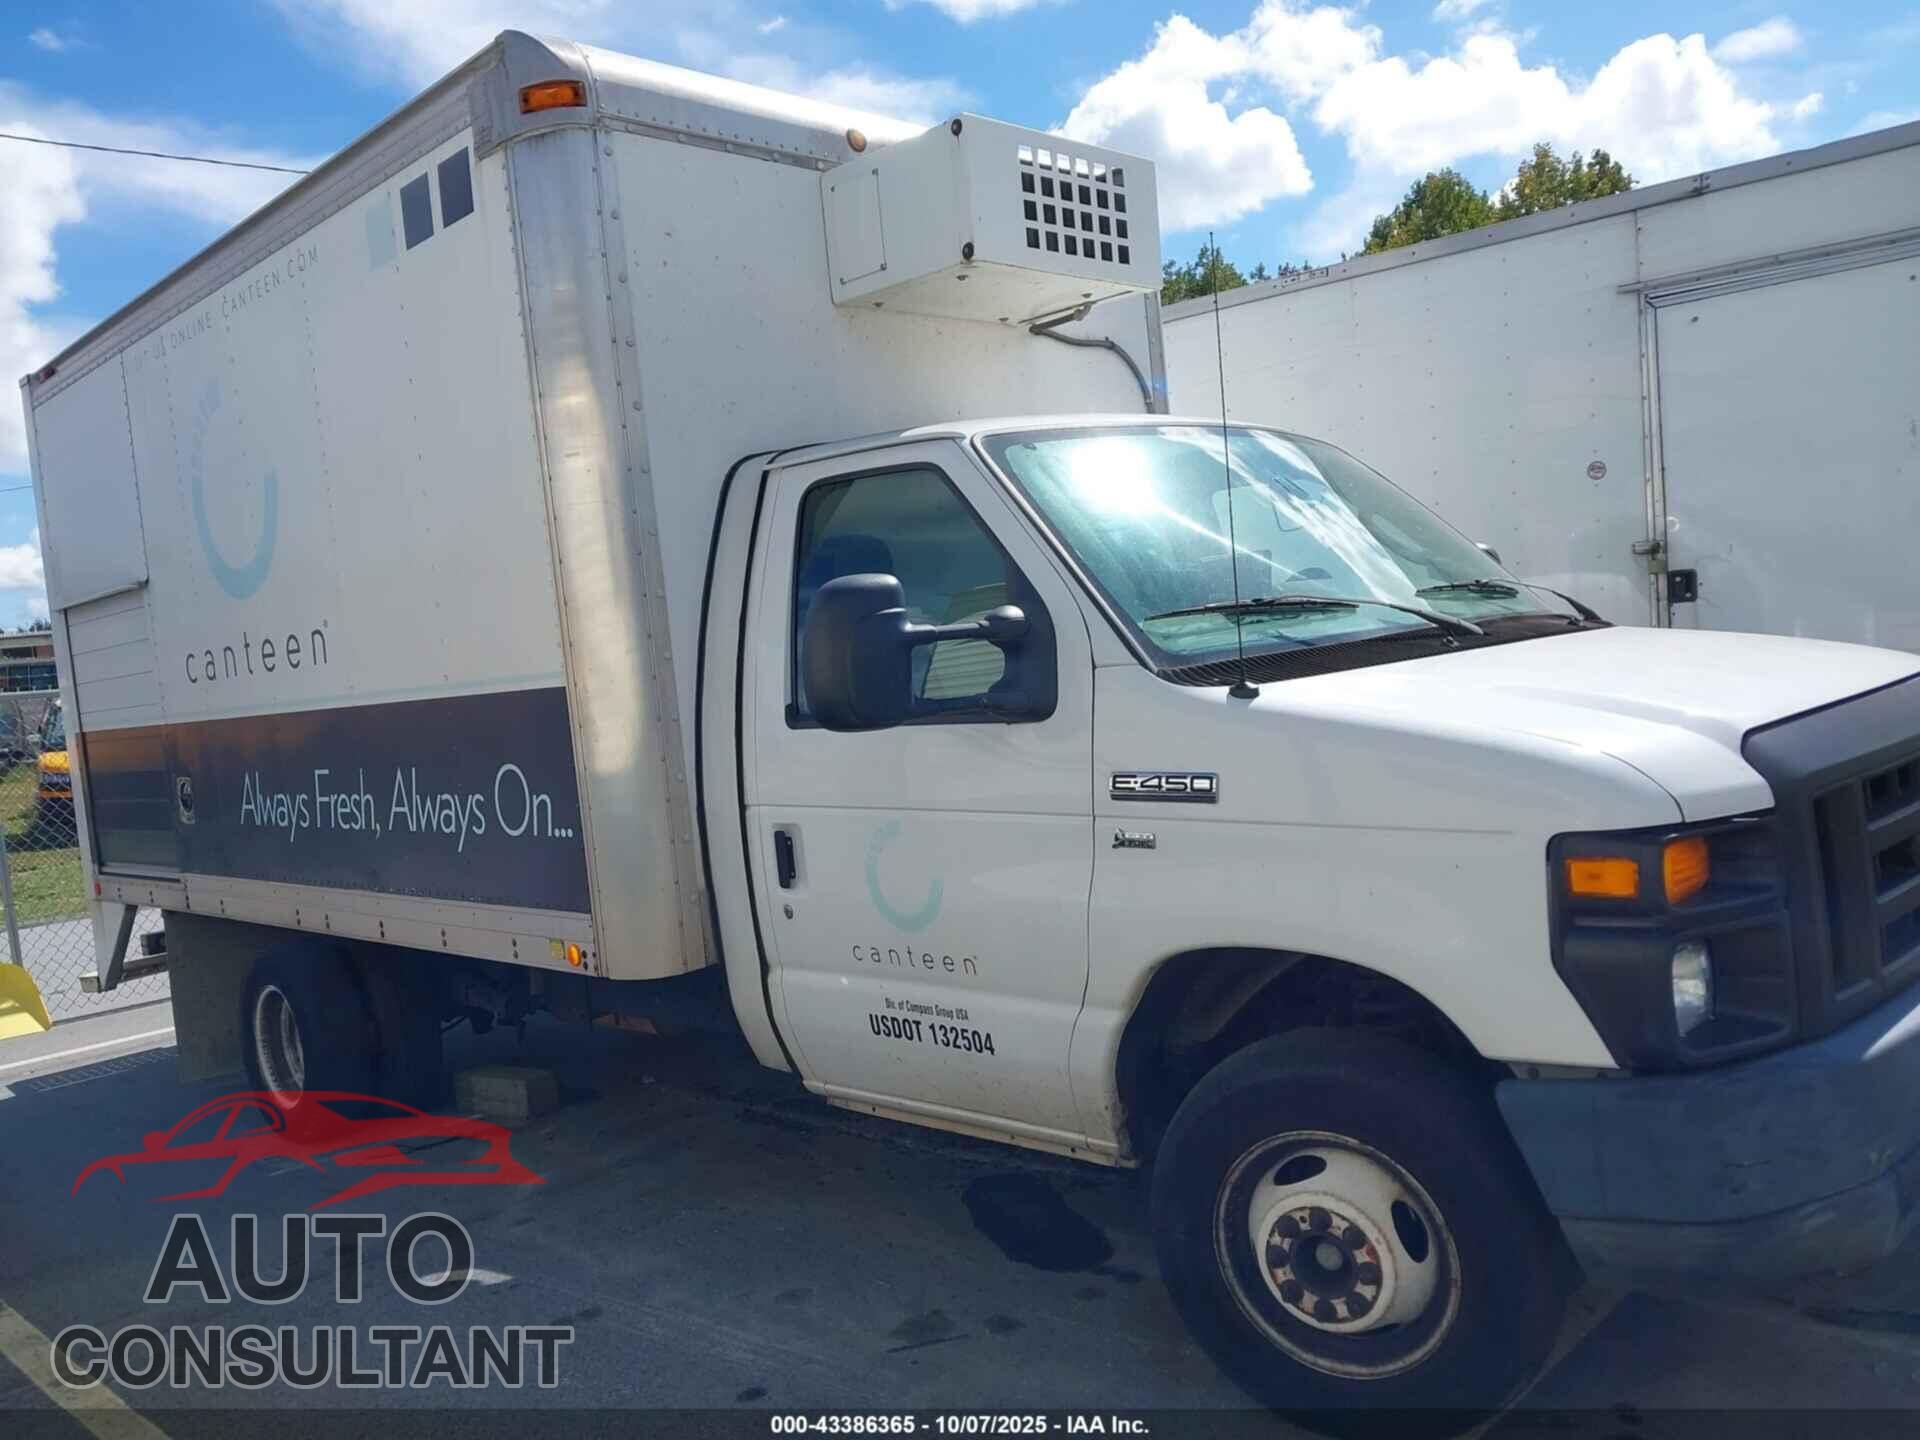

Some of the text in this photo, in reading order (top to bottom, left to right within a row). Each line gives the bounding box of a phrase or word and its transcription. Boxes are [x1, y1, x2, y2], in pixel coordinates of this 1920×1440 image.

[240, 763, 574, 852] Always Fresh, Always On...
[898, 1000, 905, 1011] of
[905, 1000, 934, 1016] Compass
[935, 1004, 955, 1021] Group
[956, 1008, 969, 1021] USA
[869, 1013, 995, 1056] USDOT 132504
